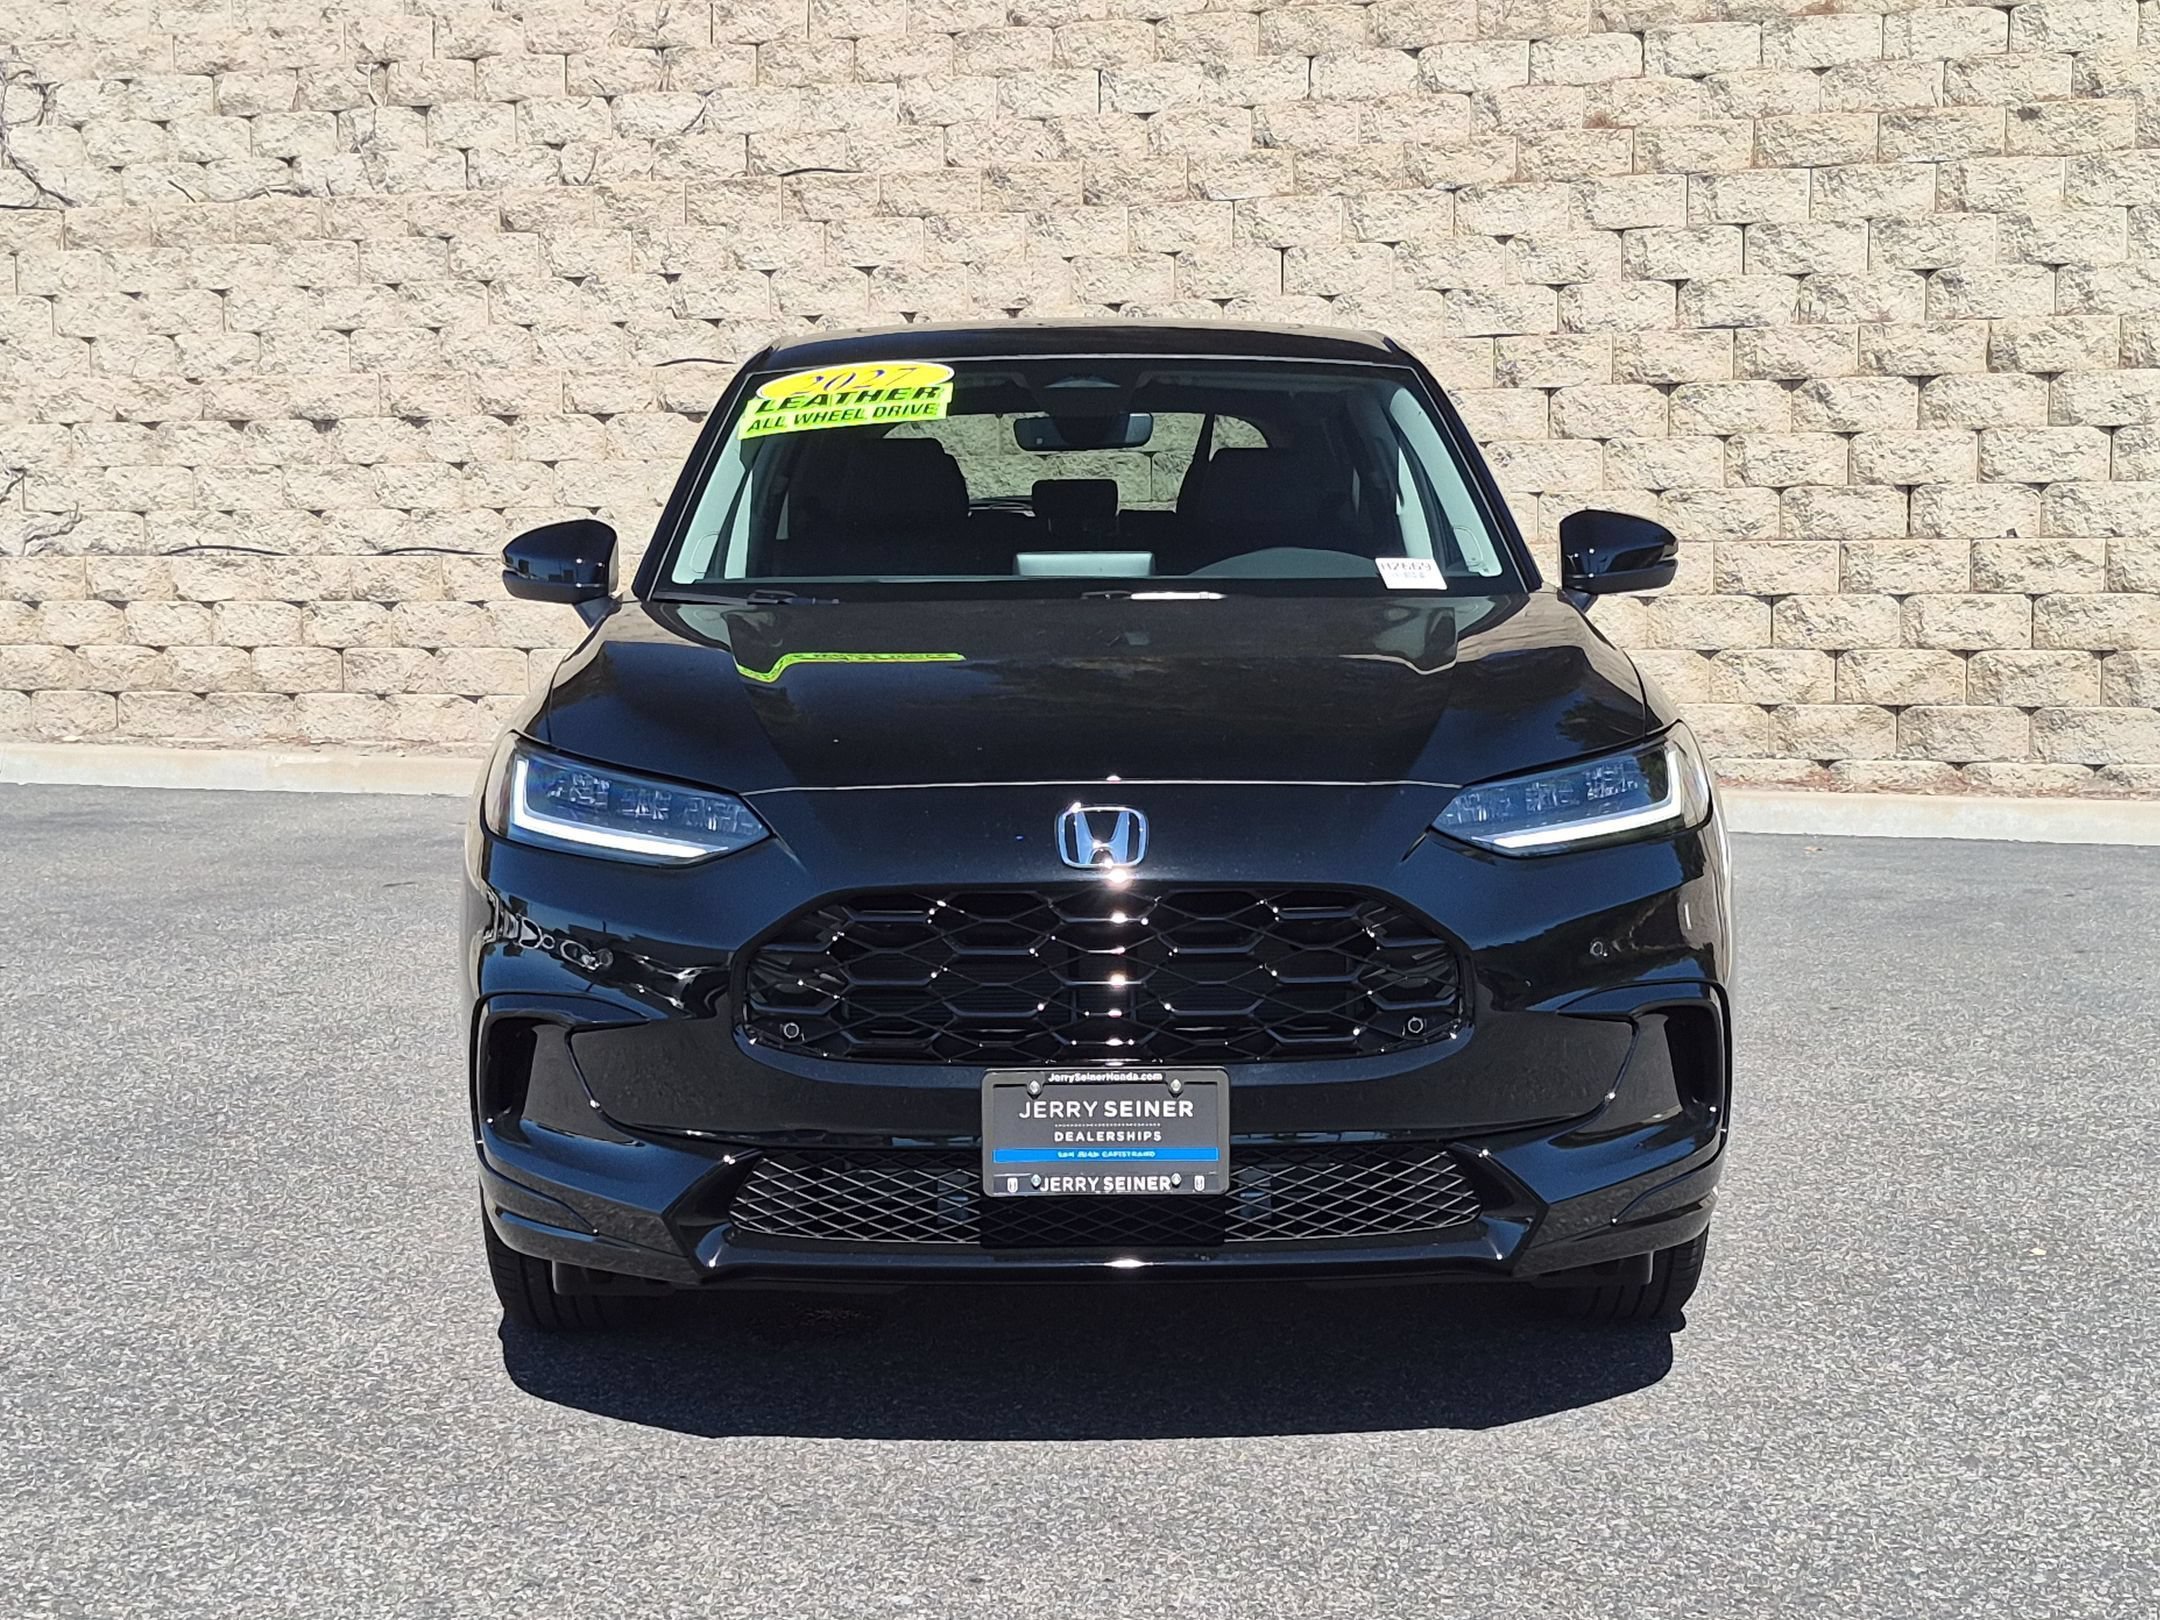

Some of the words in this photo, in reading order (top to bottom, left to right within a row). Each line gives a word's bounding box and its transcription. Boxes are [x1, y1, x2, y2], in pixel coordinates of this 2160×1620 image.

[790, 367, 918, 396] 2027
[756, 386, 943, 414] LEATHER
[747, 415, 786, 433] ALL
[794, 408, 867, 425] WHEEL
[873, 402, 938, 418] DRIVE
[1048, 1072, 1164, 1084] JerrySeinerHonda.com
[1019, 1100, 1099, 1119] JERRY
[1103, 1100, 1195, 1119] SEINER
[1054, 1130, 1163, 1142] DEALERSHIPS
[1039, 1176, 1099, 1192] JERRY
[1103, 1176, 1172, 1192] SEINER
